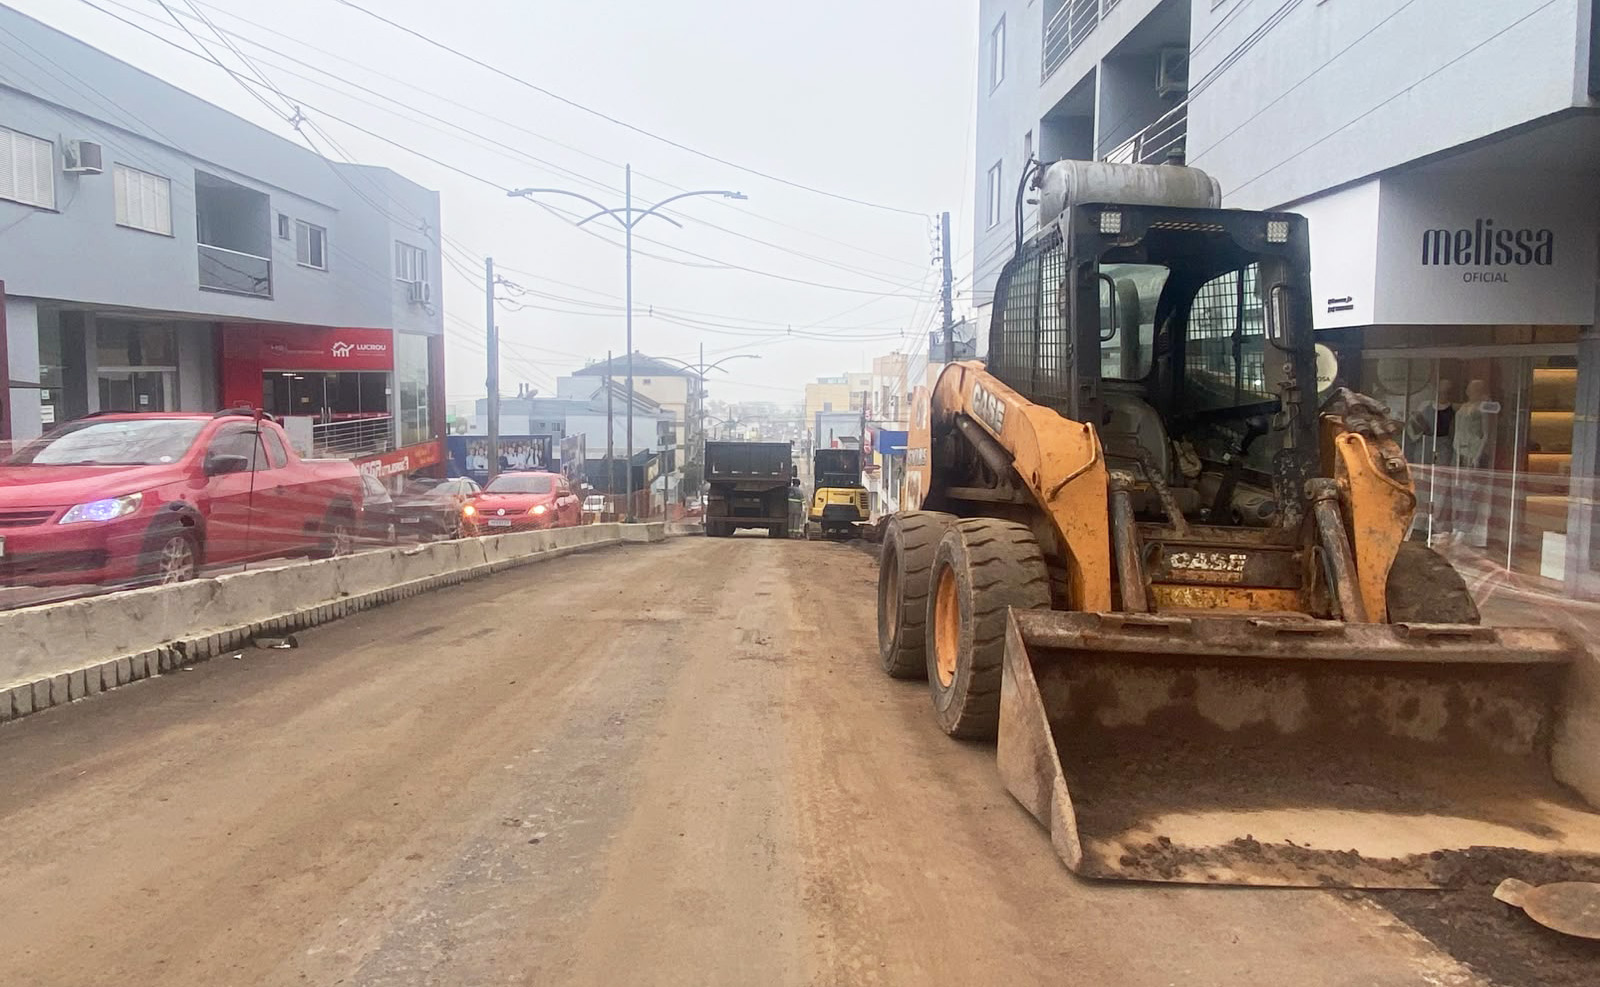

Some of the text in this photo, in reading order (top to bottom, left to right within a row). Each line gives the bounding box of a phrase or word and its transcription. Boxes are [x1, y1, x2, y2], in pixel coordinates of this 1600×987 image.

[1422, 218, 1553, 265] melissa
[1463, 272, 1508, 283] OFICIAL
[972, 382, 1006, 434] CASE
[1170, 552, 1247, 571] CASE
